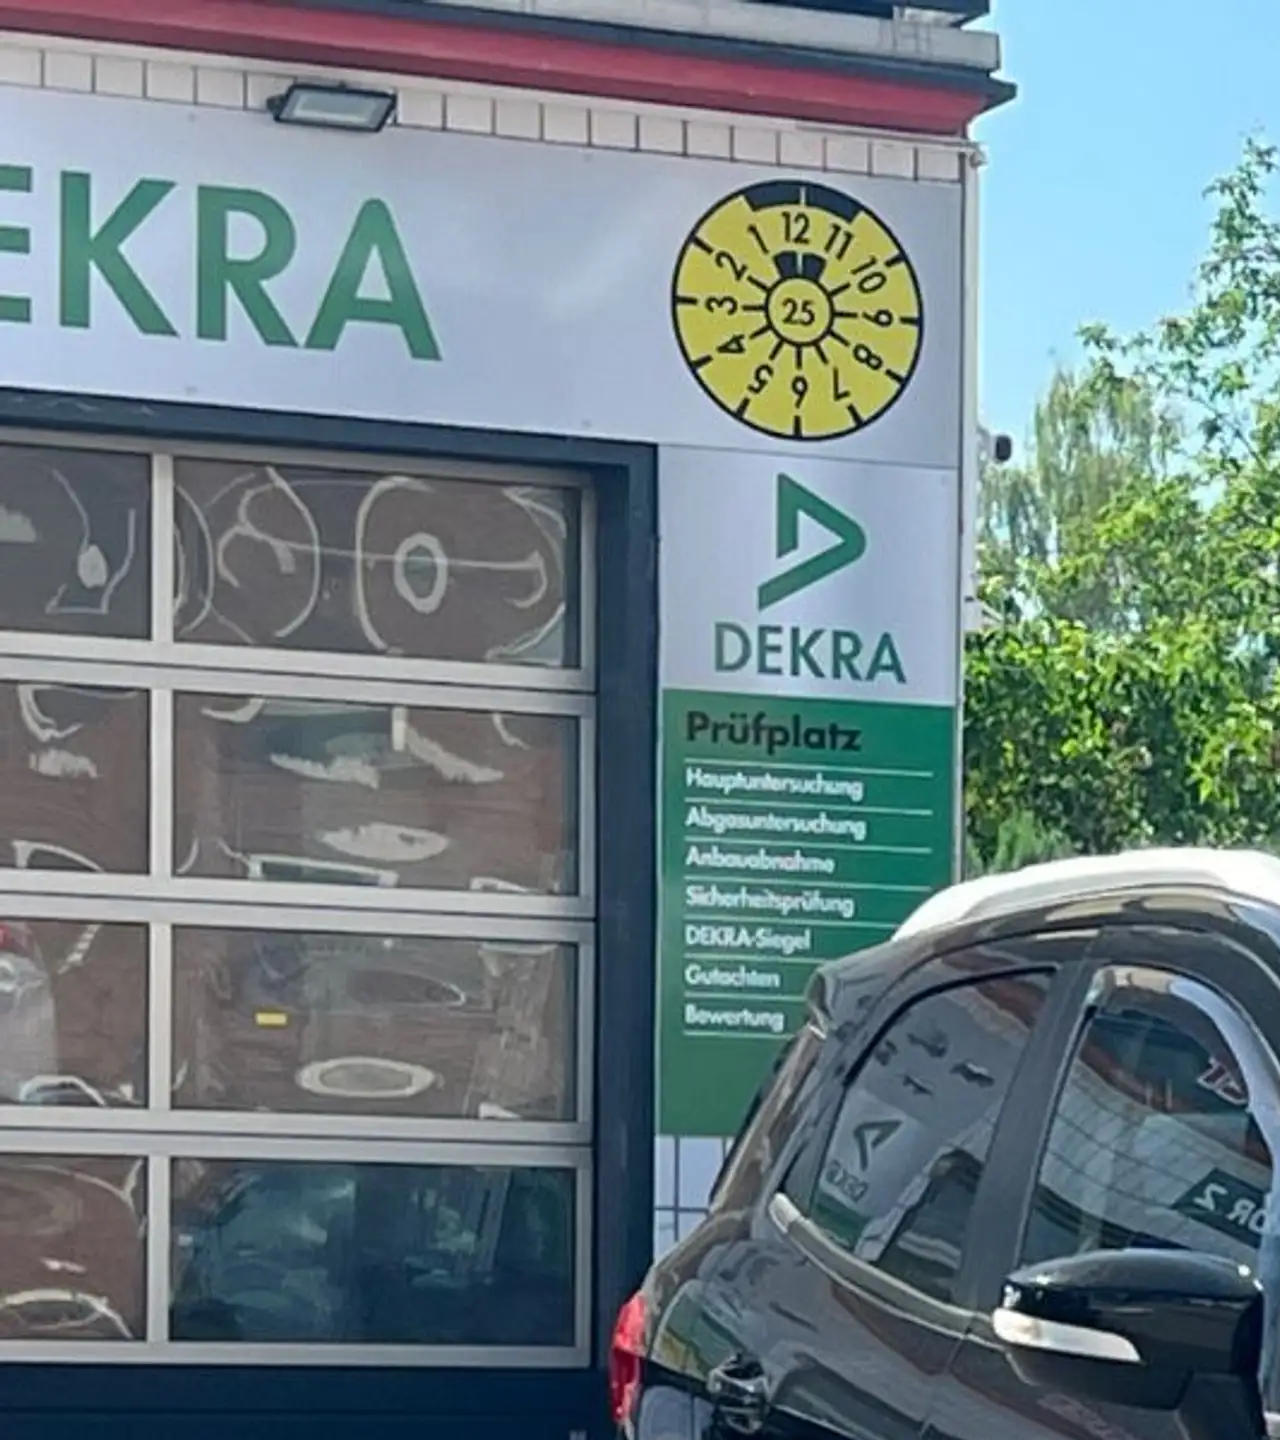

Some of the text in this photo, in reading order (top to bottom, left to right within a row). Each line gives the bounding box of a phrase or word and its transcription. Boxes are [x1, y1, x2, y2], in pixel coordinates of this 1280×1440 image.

[747, 224, 769, 255] 1
[781, 211, 811, 244] 12
[823, 223, 855, 261] 11
[714, 251, 748, 281] 2
[851, 255, 887, 294] 10
[705, 295, 738, 316] 3
[781, 298, 816, 327] 25
[715, 334, 746, 354] 4
[853, 344, 884, 371] 8
[747, 364, 774, 394] 5
[831, 367, 851, 402] 7
[714, 621, 907, 684] DEKRA
[686, 710, 862, 755] Prüfplatz
[686, 768, 864, 801] Hauptuntersuchung
[685, 806, 867, 841] Abgasuntersuchung
[686, 846, 836, 873] Anbauabnahme
[685, 885, 855, 918] Sicherheitsprüfung
[685, 924, 811, 954] DEKRA-Siegel
[685, 964, 780, 988] Gutachten
[685, 1004, 785, 1033] Bewertung
